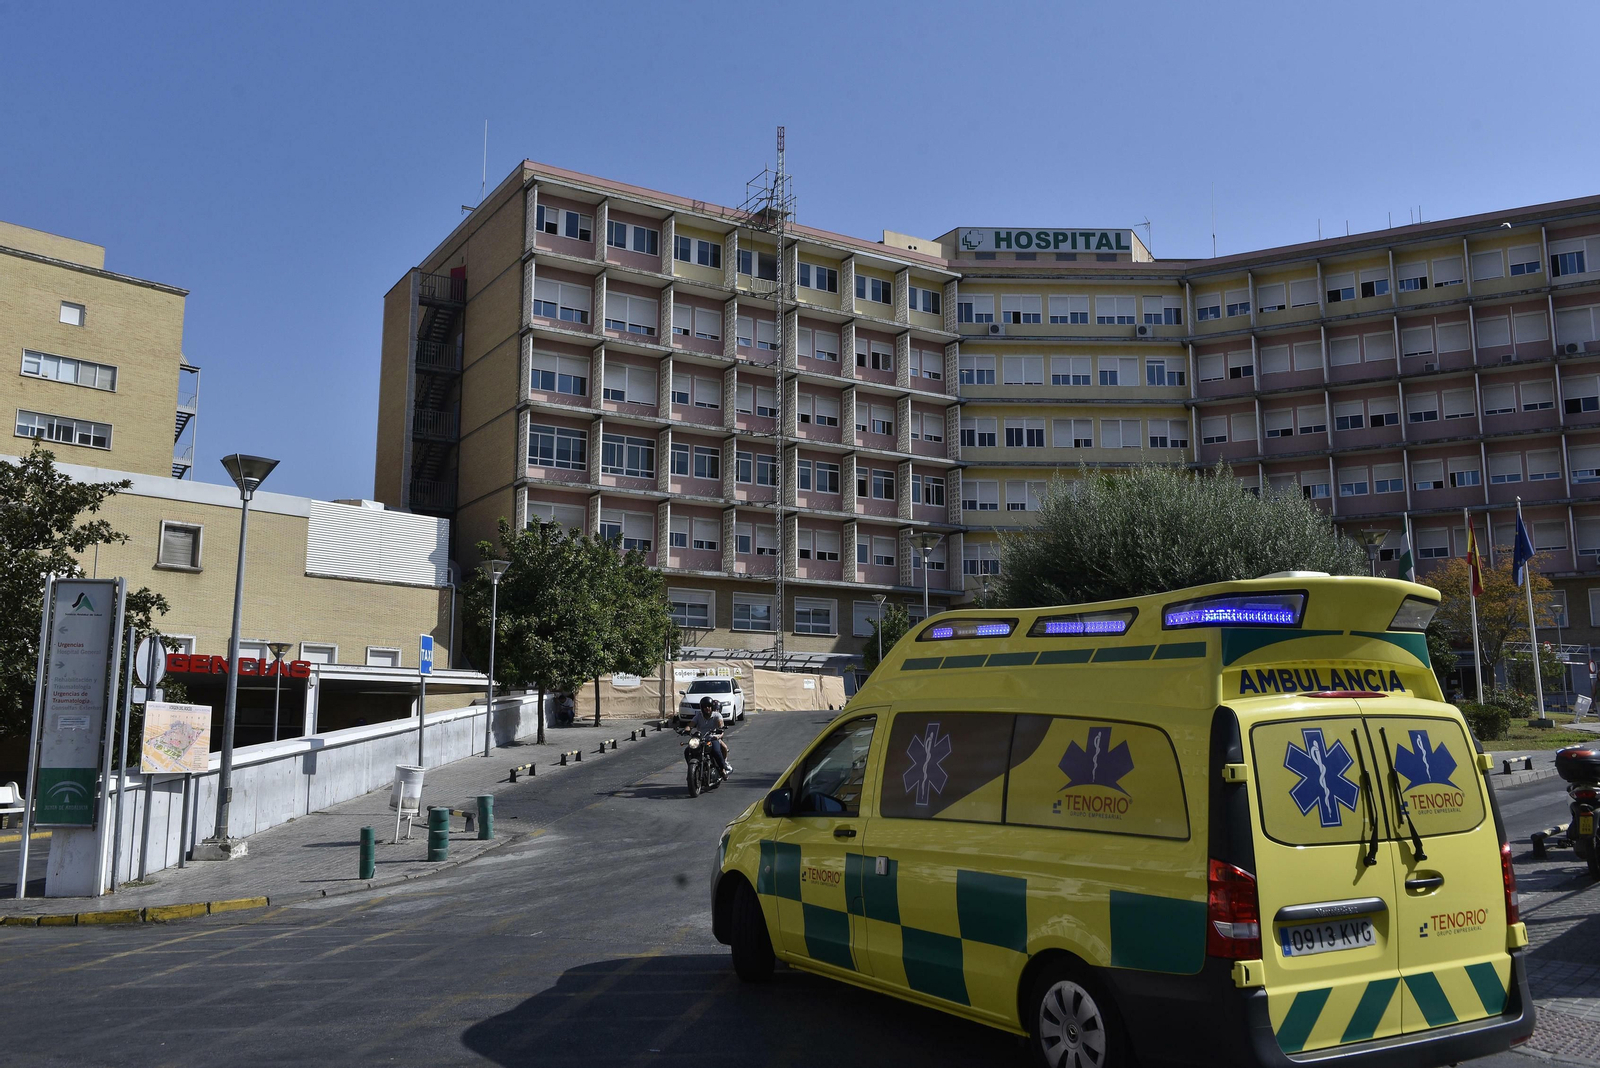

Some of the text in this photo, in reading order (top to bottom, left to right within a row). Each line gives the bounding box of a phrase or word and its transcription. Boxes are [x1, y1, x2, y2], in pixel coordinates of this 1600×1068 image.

[994, 231, 1130, 250] HOSPITAL
[421, 649, 432, 661] TAXI
[167, 653, 311, 678] GENCIAS
[1240, 669, 1405, 694] AMBULANCIA
[1064, 794, 1129, 814] TENORIO
[1410, 792, 1464, 809] TENORIO
[807, 867, 840, 884] TENORIO
[1431, 908, 1487, 931] TENORIO
[1292, 926, 1336, 952] 0913
[1340, 921, 1372, 946] KVG
[1453, 926, 1482, 935] EMPRESARIAL
